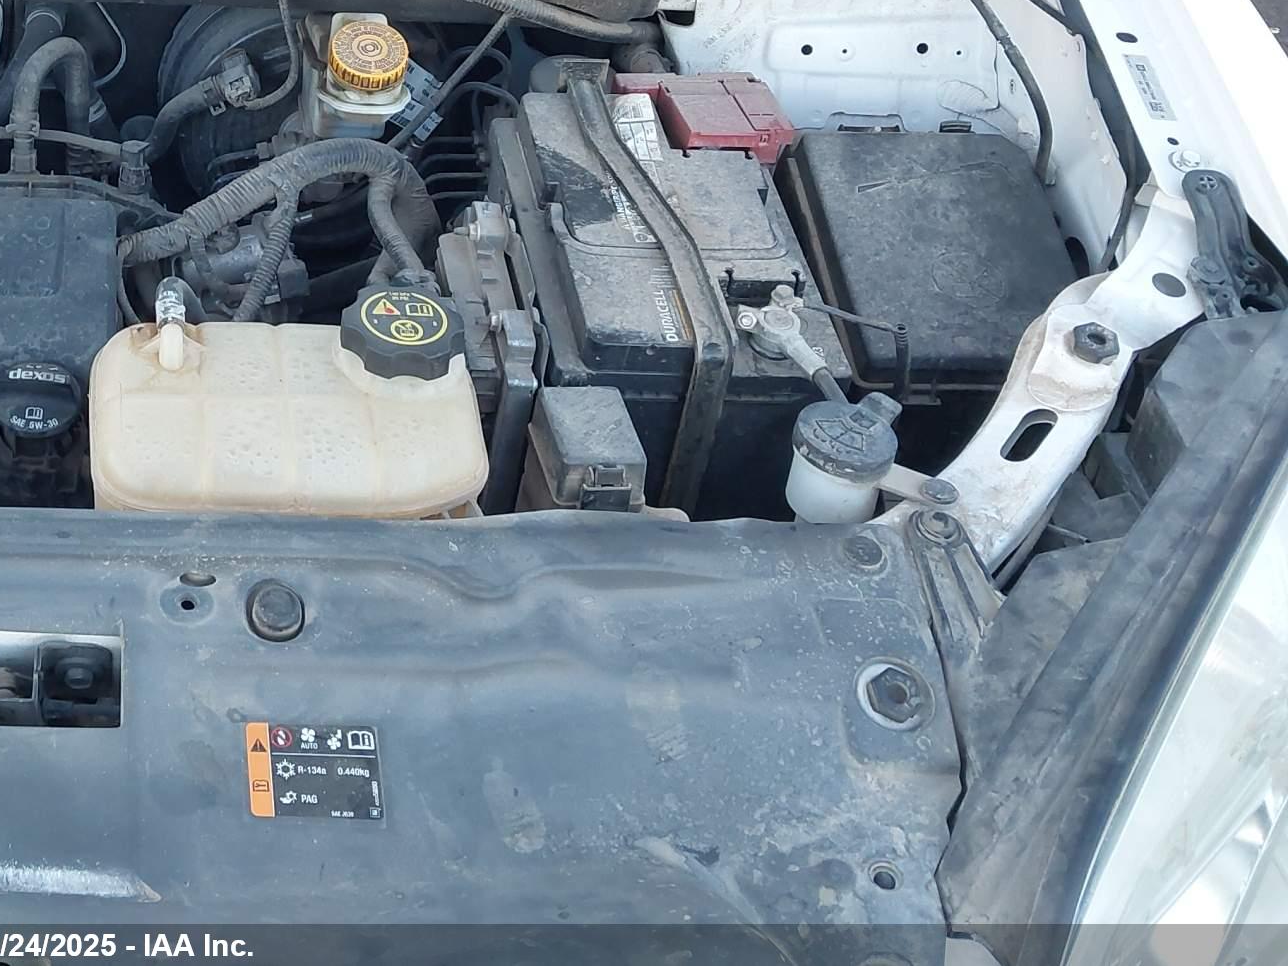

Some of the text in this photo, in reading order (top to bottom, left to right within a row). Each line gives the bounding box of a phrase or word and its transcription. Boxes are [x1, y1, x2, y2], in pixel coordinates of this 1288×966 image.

[653, 289, 679, 342] DURACELL
[8, 368, 66, 384] dexos
[10, 415, 59, 430] SAE 5W-30
[300, 741, 319, 750] AUTO
[298, 766, 370, 778] R-134a 0.440kg
[300, 793, 319, 804] PAG
